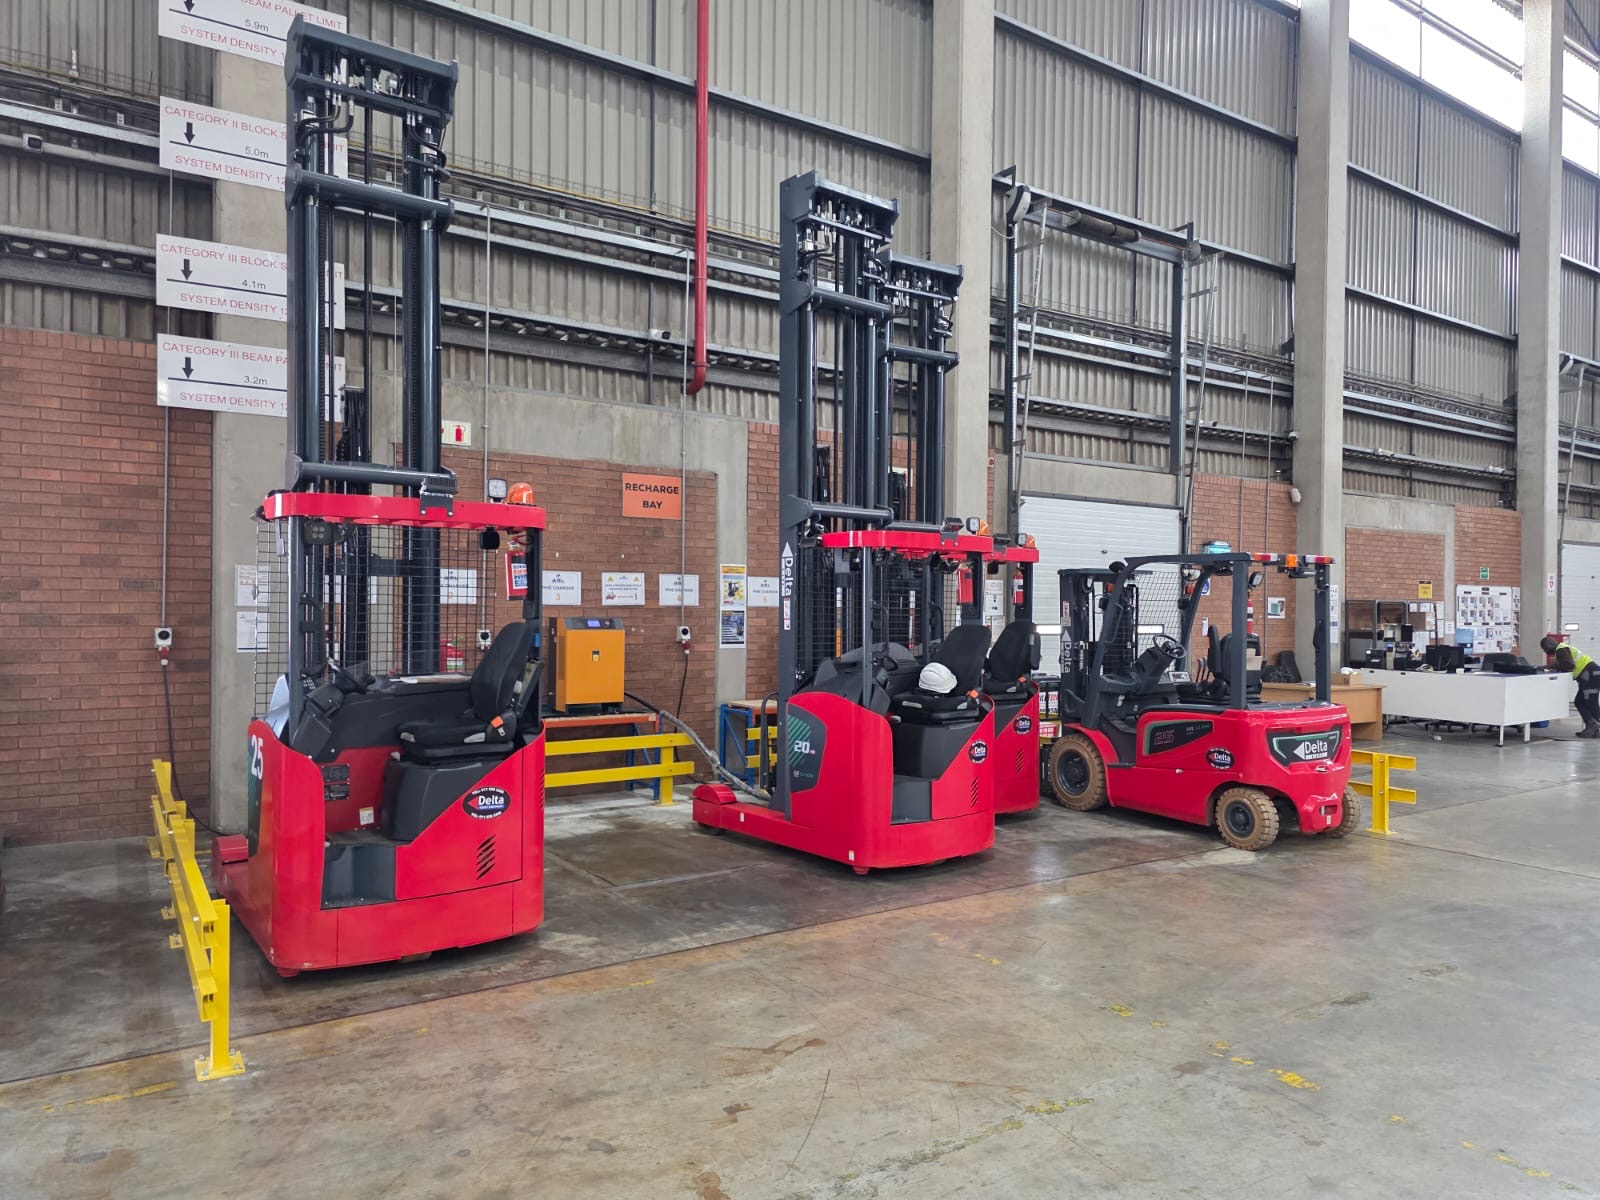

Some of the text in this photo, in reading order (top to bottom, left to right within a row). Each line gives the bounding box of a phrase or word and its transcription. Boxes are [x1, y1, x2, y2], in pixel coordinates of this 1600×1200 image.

[245, 19, 269, 32] 5.9m
[316, 16, 343, 30] LIMIT
[180, 24, 227, 43] SYSTEM
[230, 38, 277, 57] DENSITY
[164, 105, 228, 127] CATEGORY
[232, 120, 238, 129] II
[241, 122, 278, 138] BLOCK
[245, 146, 269, 158] 5.0m
[175, 155, 222, 172] SYSTEM
[225, 165, 272, 182] DENSITY
[160, 243, 225, 260] CATEGORY
[228, 254, 238, 263] III
[240, 255, 278, 268] BLOCK
[241, 279, 266, 289] 4.1m
[180, 293, 227, 307] SYSTEM
[230, 299, 277, 313] DENSITY
[162, 342, 226, 357] CATEGORY
[229, 350, 239, 359] III
[242, 351, 273, 363] BEAM
[244, 375, 268, 385] 3.2m
[179, 391, 227, 404] SYSTEM
[229, 396, 277, 409] DENSITY
[625, 482, 680, 495] RECHARGE
[642, 500, 663, 509] BAY
[785, 558, 794, 596] Delta
[1064, 642, 1072, 673] Delta
[1154, 730, 1175, 745] 25
[794, 740, 810, 754] 20
[1305, 740, 1328, 754] Delta
[251, 734, 264, 780] 25
[1214, 752, 1231, 762] Delta
[478, 794, 505, 806] Delta
